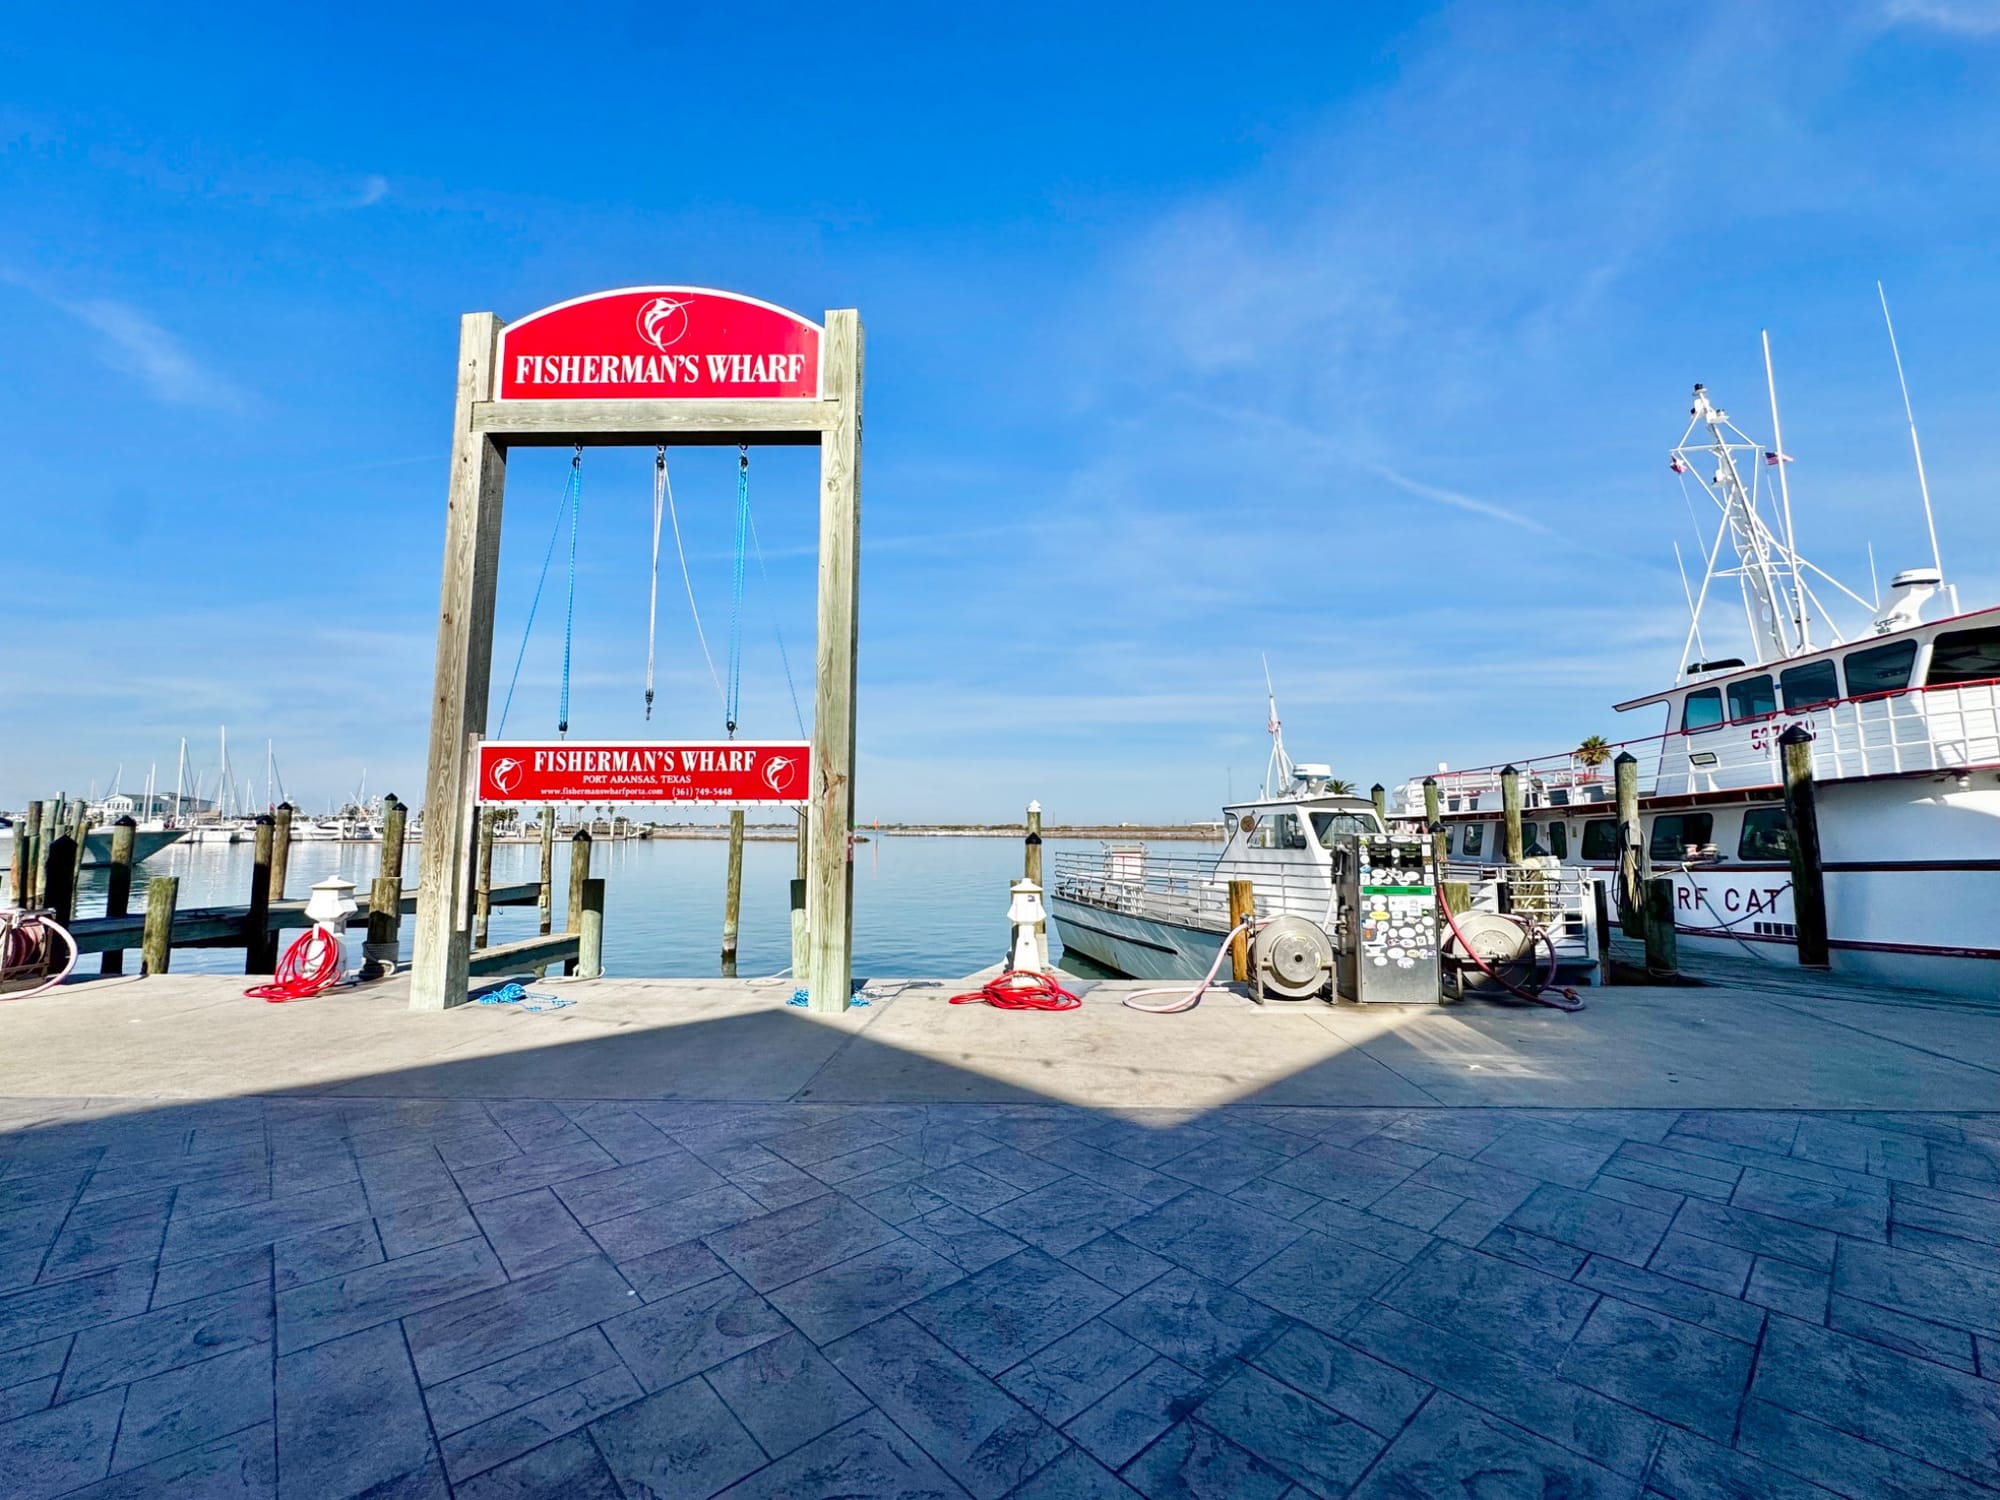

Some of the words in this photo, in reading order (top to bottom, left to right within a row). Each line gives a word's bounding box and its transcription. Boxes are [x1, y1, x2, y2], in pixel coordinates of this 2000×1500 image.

[515, 354, 699, 384] FISHERMAN'S
[706, 353, 805, 382] WHARF
[534, 750, 675, 772] FISHERMAN'S
[680, 750, 757, 772] WHARF
[583, 775, 607, 784] PORT
[610, 775, 658, 785] ARANSAS,
[660, 775, 692, 784] TEXAS
[540, 787, 664, 797] www.fishermanswharfporta.com
[672, 787, 694, 797] (361)
[695, 787, 733, 797] 749-5448
[1724, 888, 1781, 914] CAT
